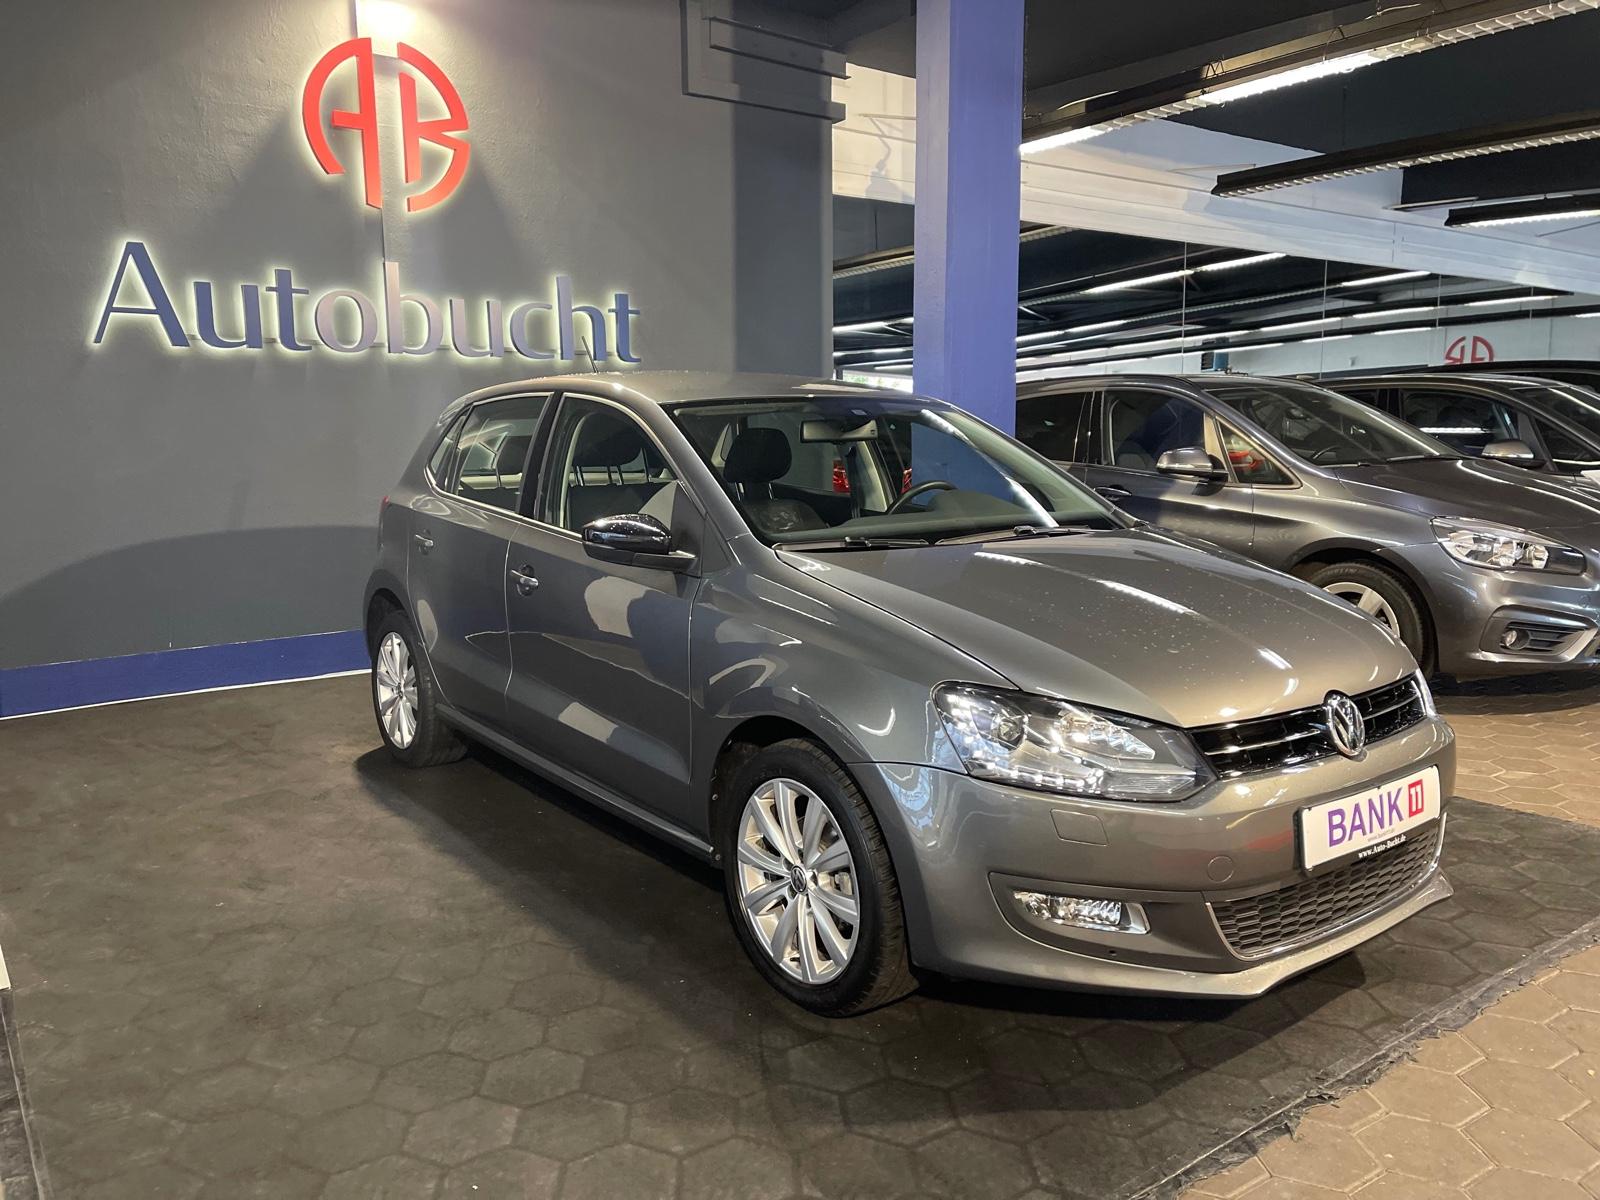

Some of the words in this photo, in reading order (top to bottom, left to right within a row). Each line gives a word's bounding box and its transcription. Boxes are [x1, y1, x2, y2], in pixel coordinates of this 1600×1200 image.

[302, 37, 471, 212] AB
[92, 241, 642, 363] Autobucht
[1327, 786, 1404, 848] BANK
